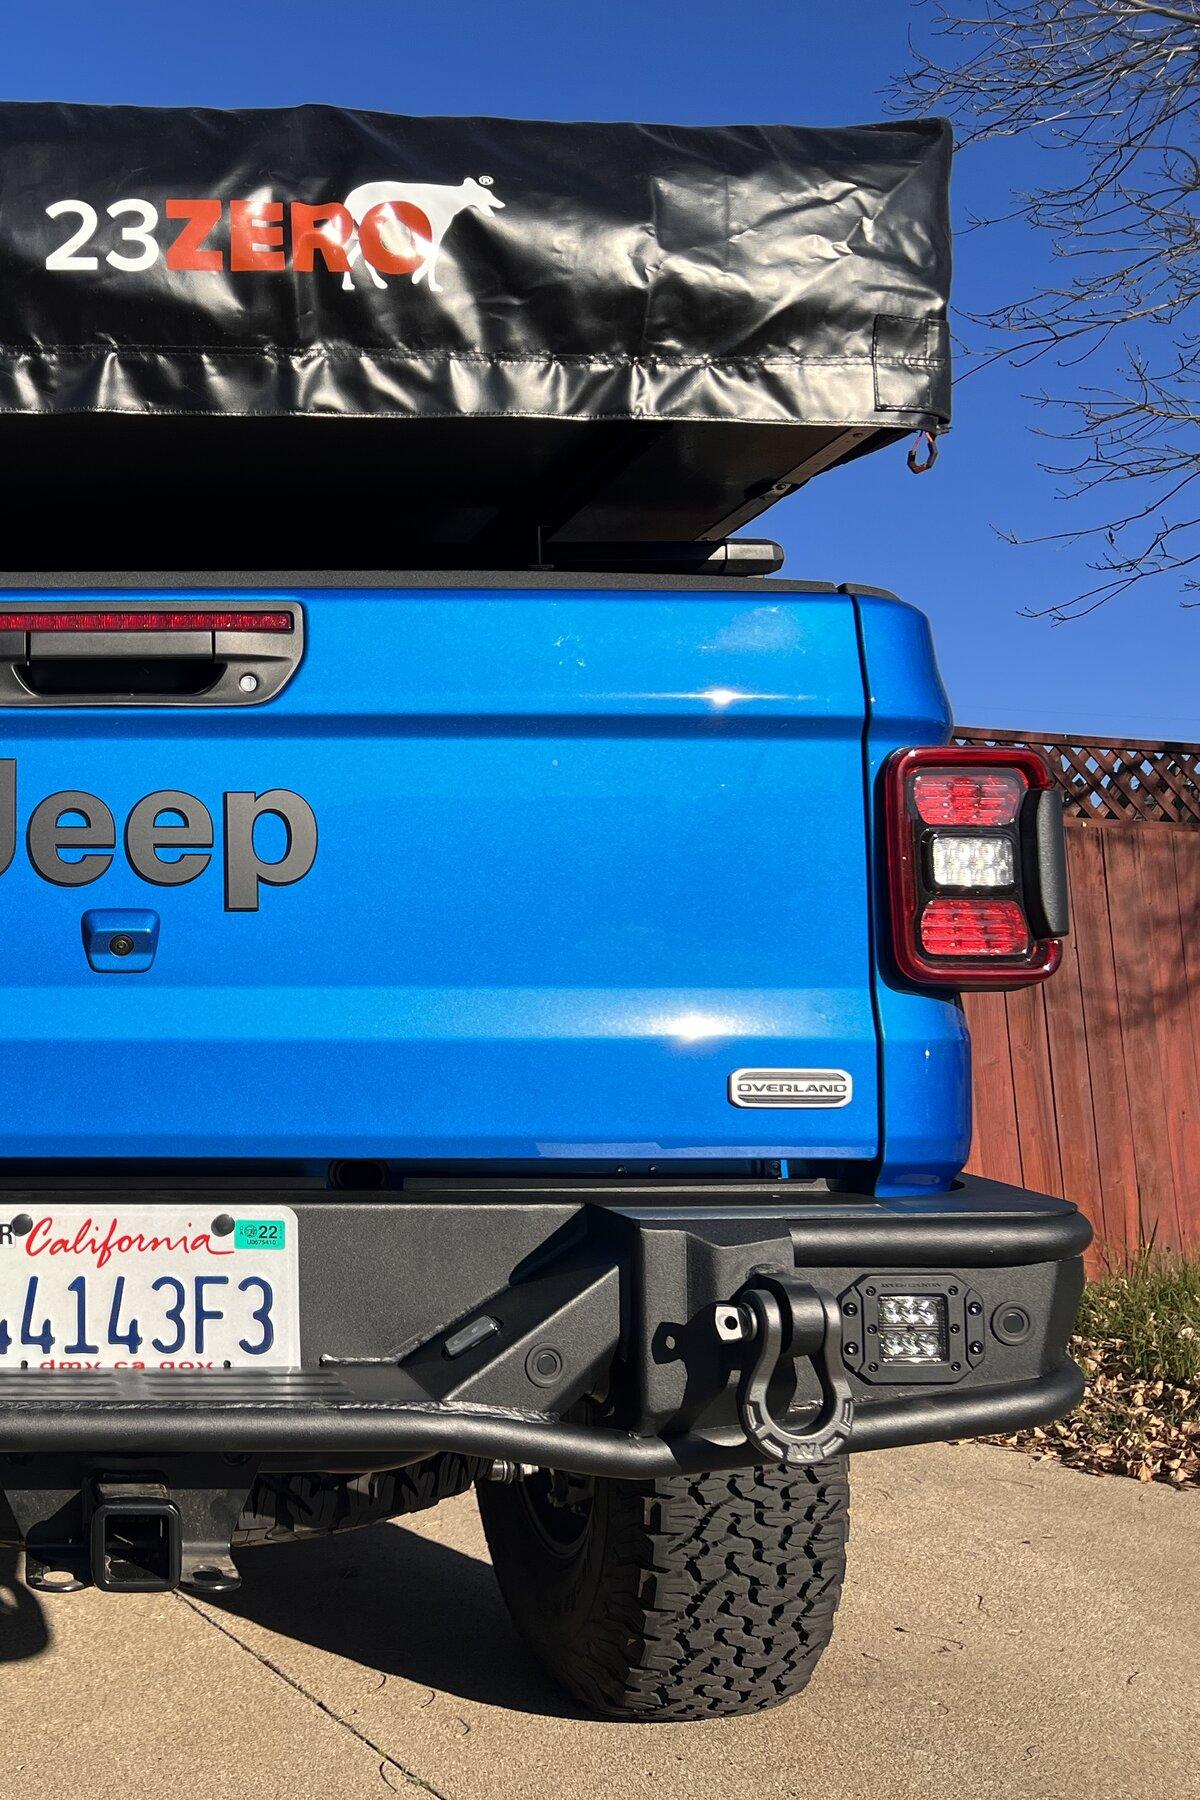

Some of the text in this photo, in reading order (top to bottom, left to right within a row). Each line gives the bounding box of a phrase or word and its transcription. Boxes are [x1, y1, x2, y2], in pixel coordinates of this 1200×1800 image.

[45, 199, 433, 274] 23ZERO
[737, 1083, 847, 1093] OVERLAND
[25, 1216, 235, 1269] California
[258, 1225, 278, 1239] 22
